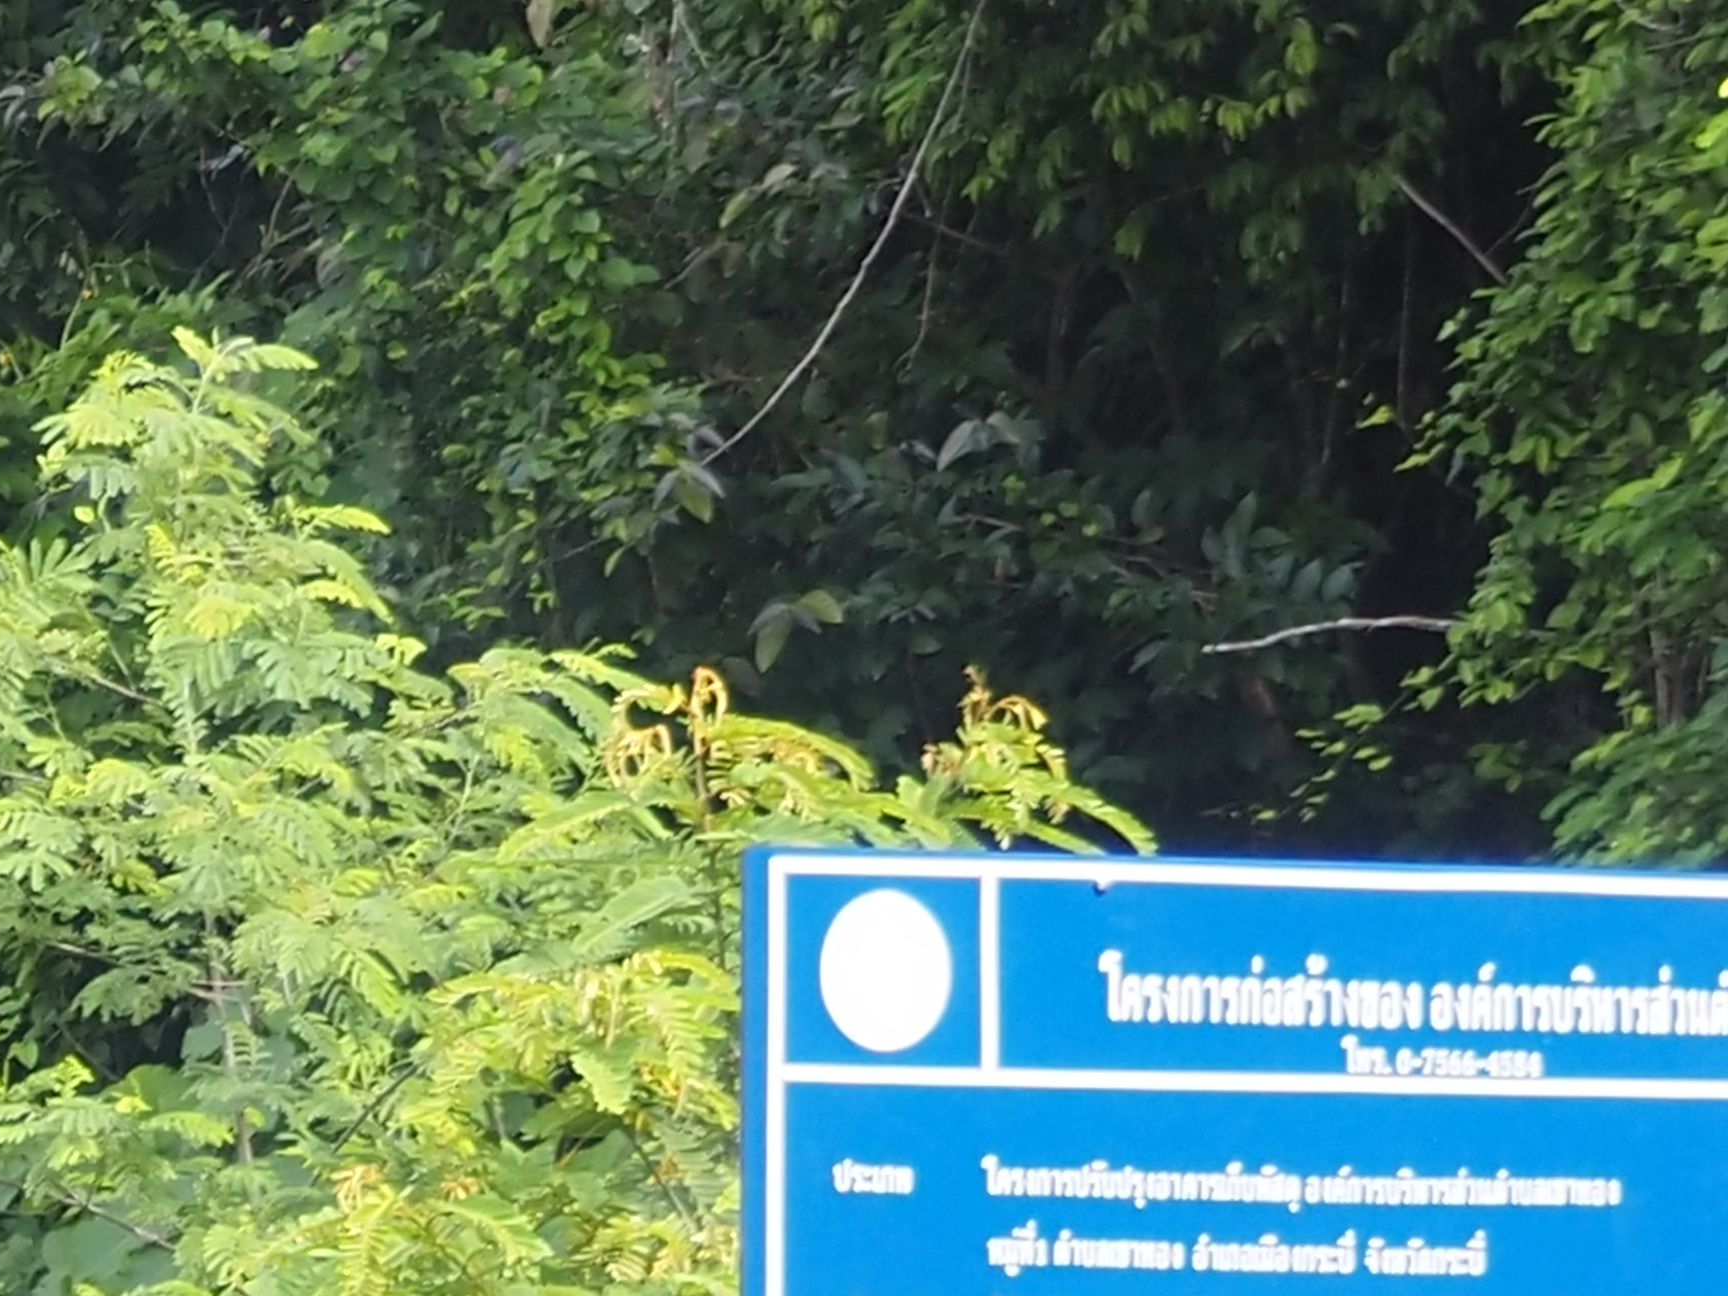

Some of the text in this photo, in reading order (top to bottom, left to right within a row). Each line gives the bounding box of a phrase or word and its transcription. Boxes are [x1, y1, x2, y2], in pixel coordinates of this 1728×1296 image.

[1098, 949, 1728, 1036] โครงการก่อสร้างของ องค์การบริหารส่วนต
[832, 1158, 914, 1194] ประเภท
